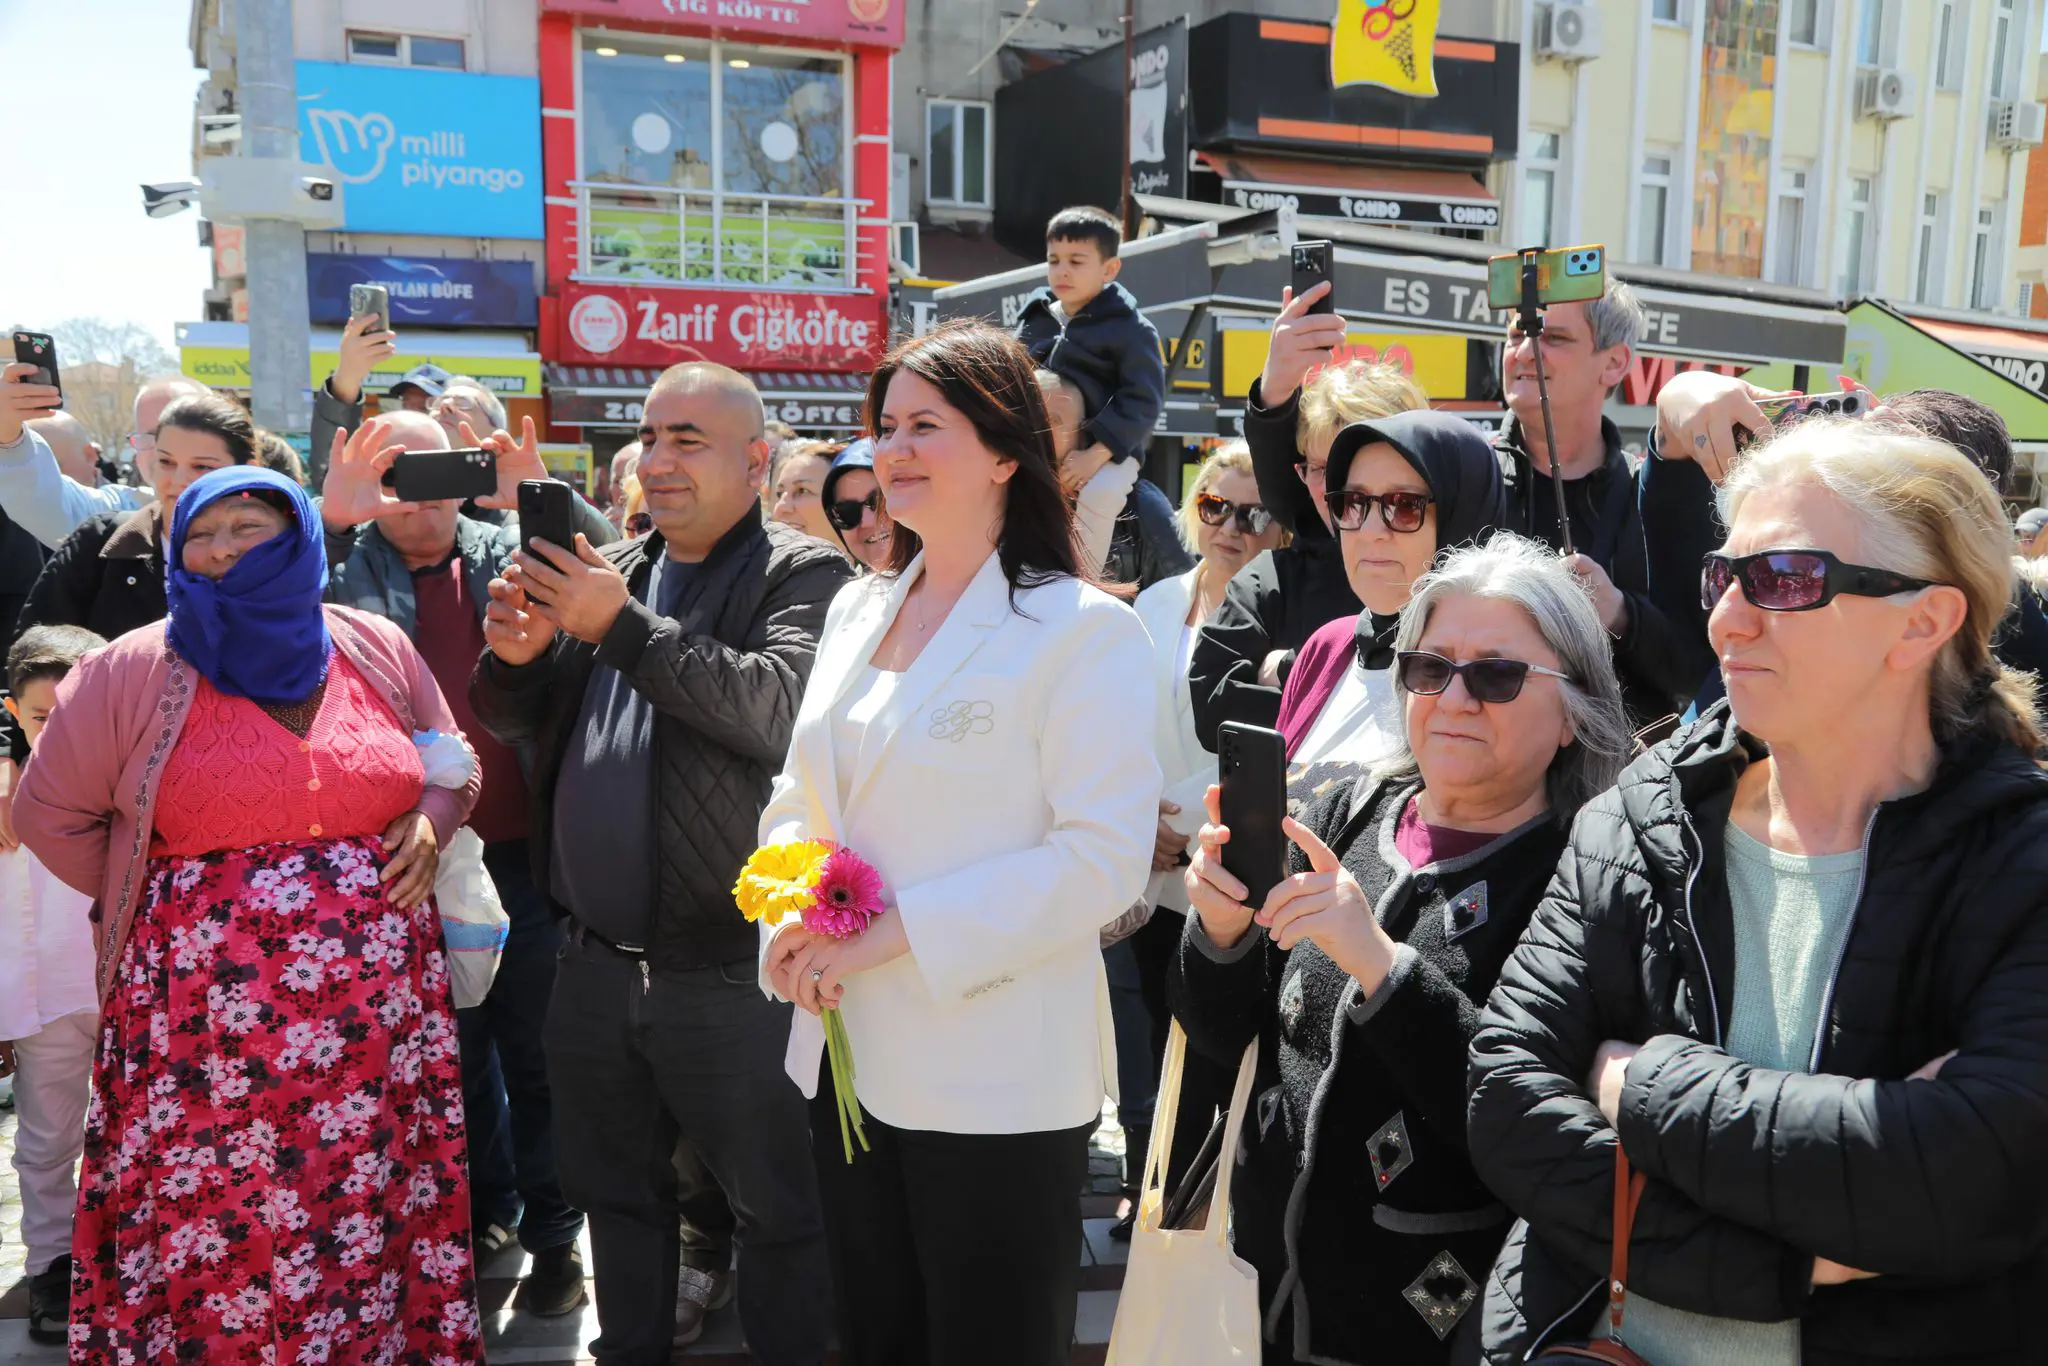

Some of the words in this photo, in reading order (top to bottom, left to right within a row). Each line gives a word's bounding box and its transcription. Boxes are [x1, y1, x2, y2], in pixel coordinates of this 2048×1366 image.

[717, 0, 799, 24] KÖFTE
[401, 131, 465, 157] milli
[402, 159, 525, 193] piyango
[1249, 192, 1299, 212] ONDO
[1353, 200, 1400, 219] ONDO
[1453, 206, 1498, 225] ONDO
[431, 280, 474, 300] BÜFE
[1384, 277, 1430, 316] ES
[637, 301, 719, 342] Zarif
[729, 304, 869, 352] Çiğköfte
